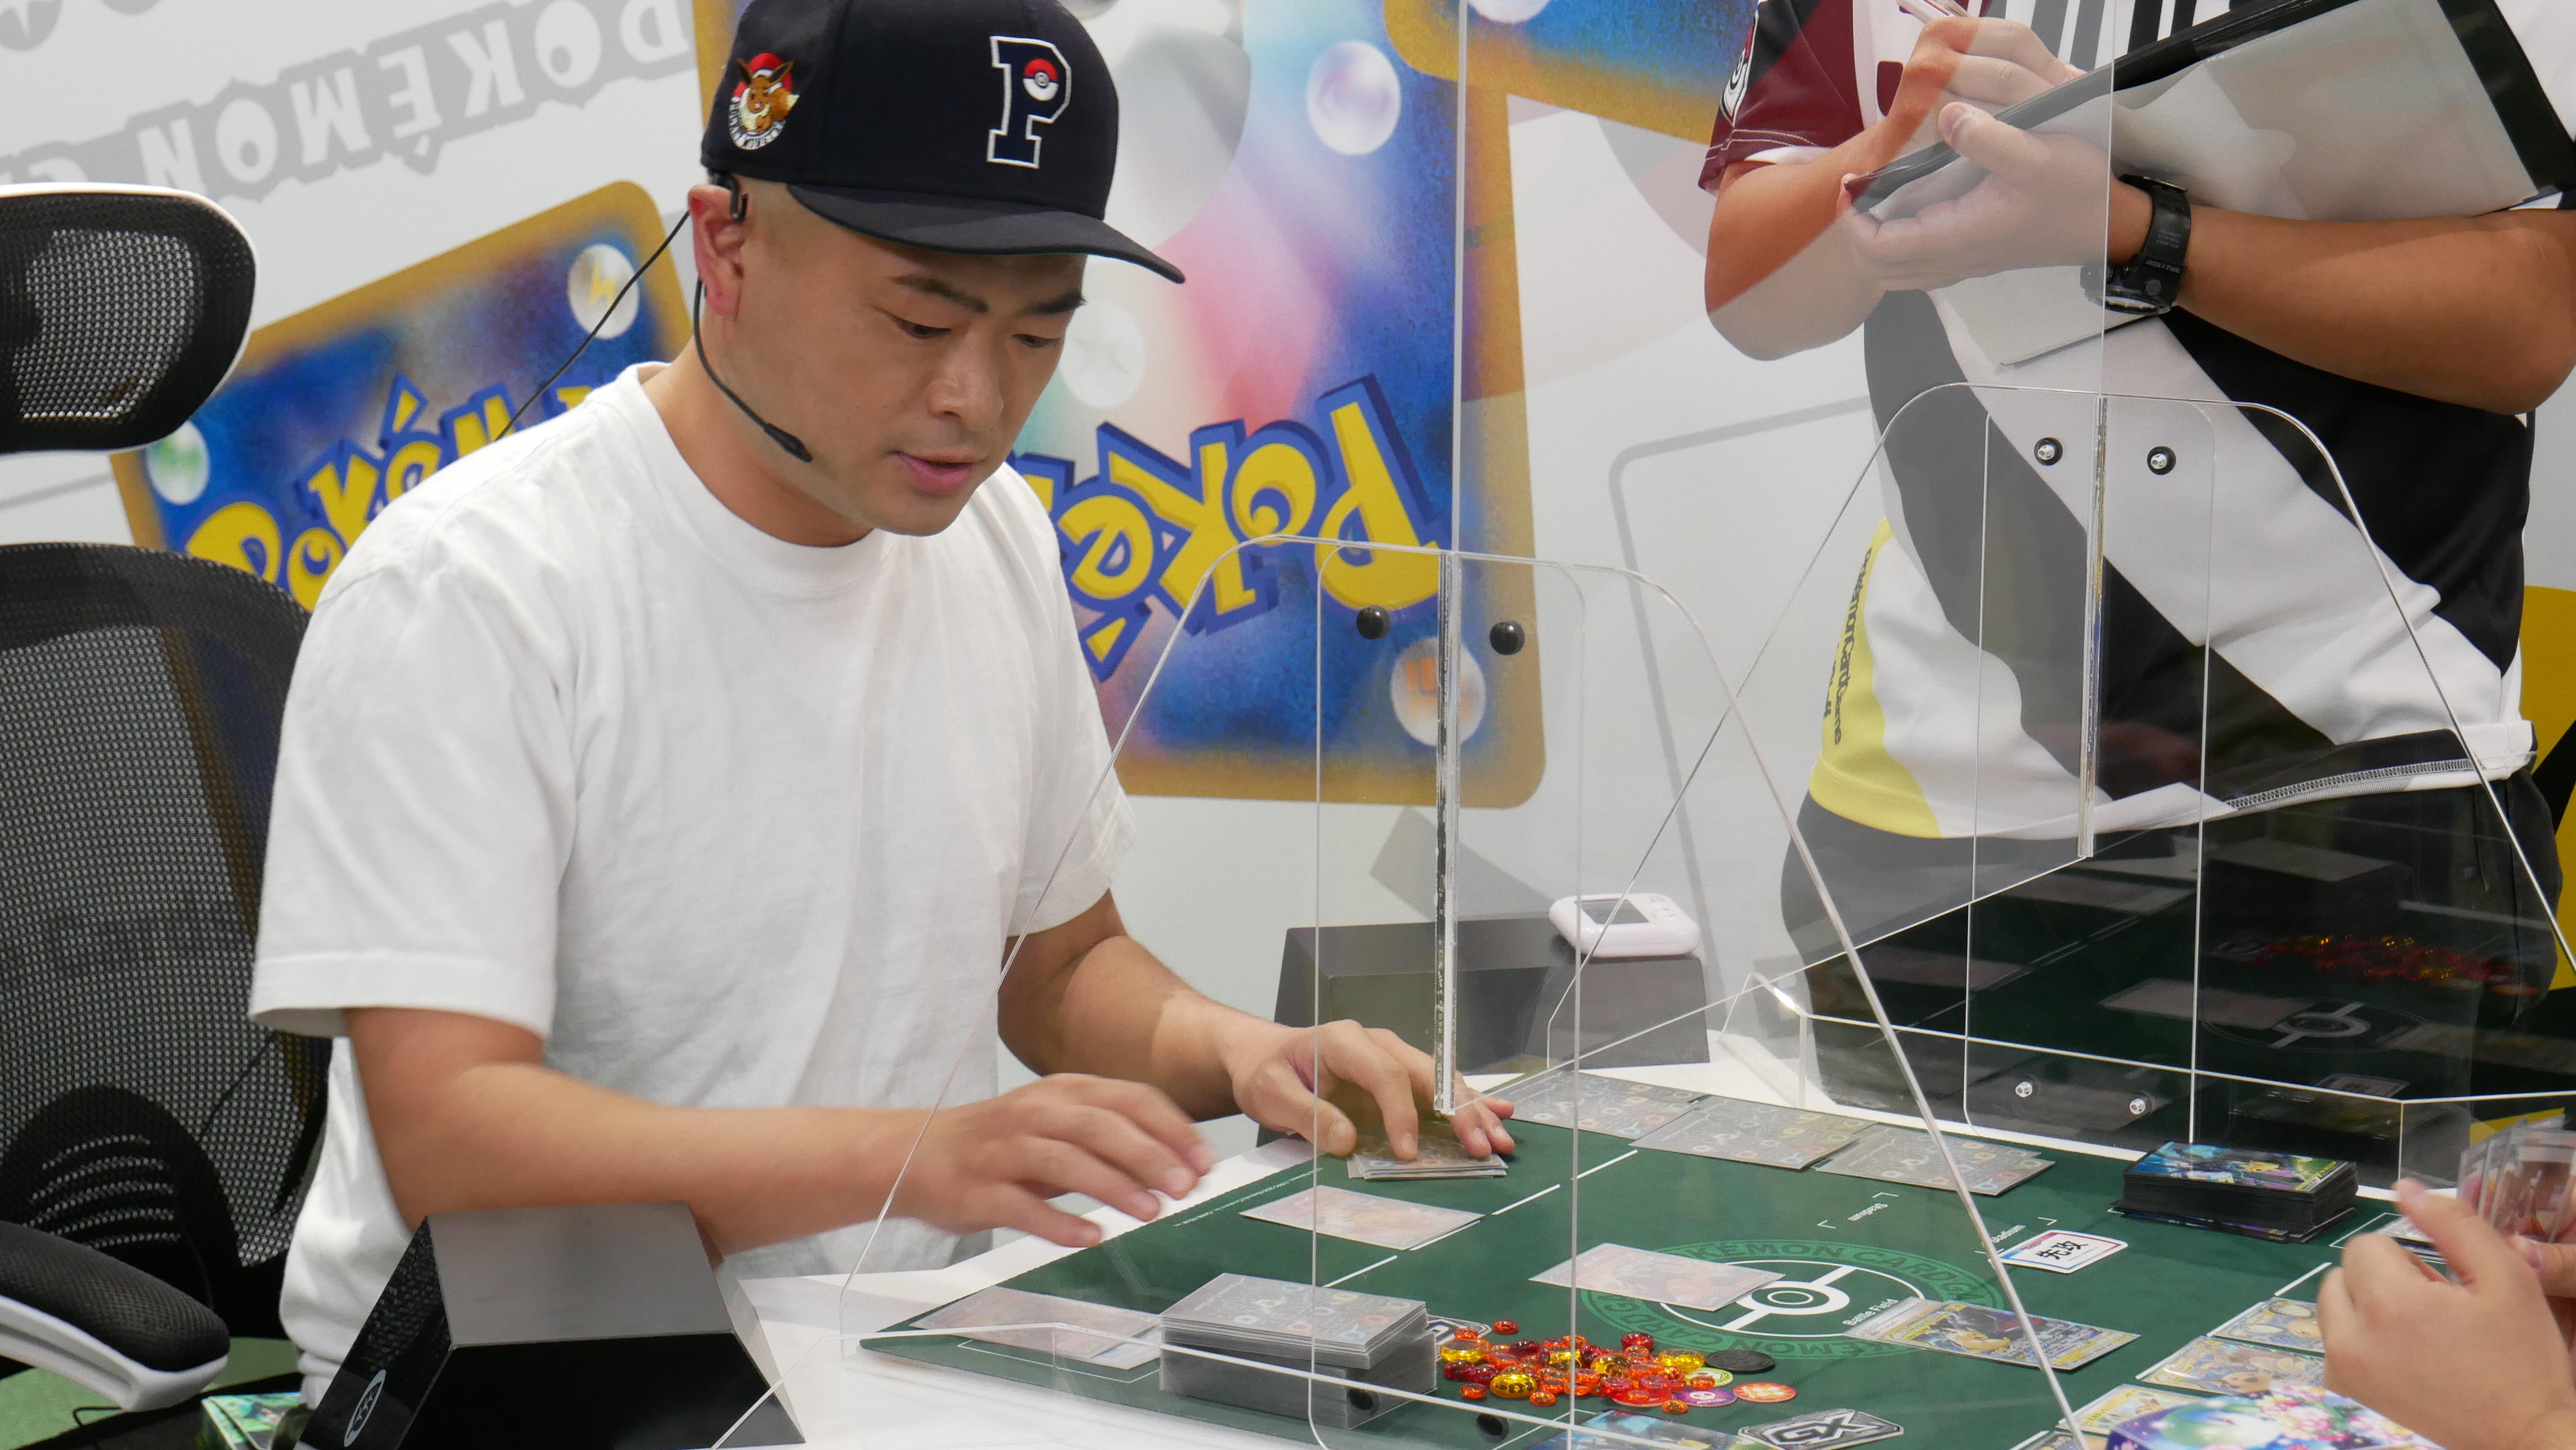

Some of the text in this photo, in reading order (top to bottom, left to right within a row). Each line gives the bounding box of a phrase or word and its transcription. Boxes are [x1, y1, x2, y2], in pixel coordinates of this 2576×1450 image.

[987, 36, 1071, 168] P
[1685, 1241, 1846, 1259] KÉMON
[1851, 1251, 1958, 1281] CARD
[1842, 1298, 1899, 1325] Battle Field
[1764, 1408, 1880, 1446] GX
